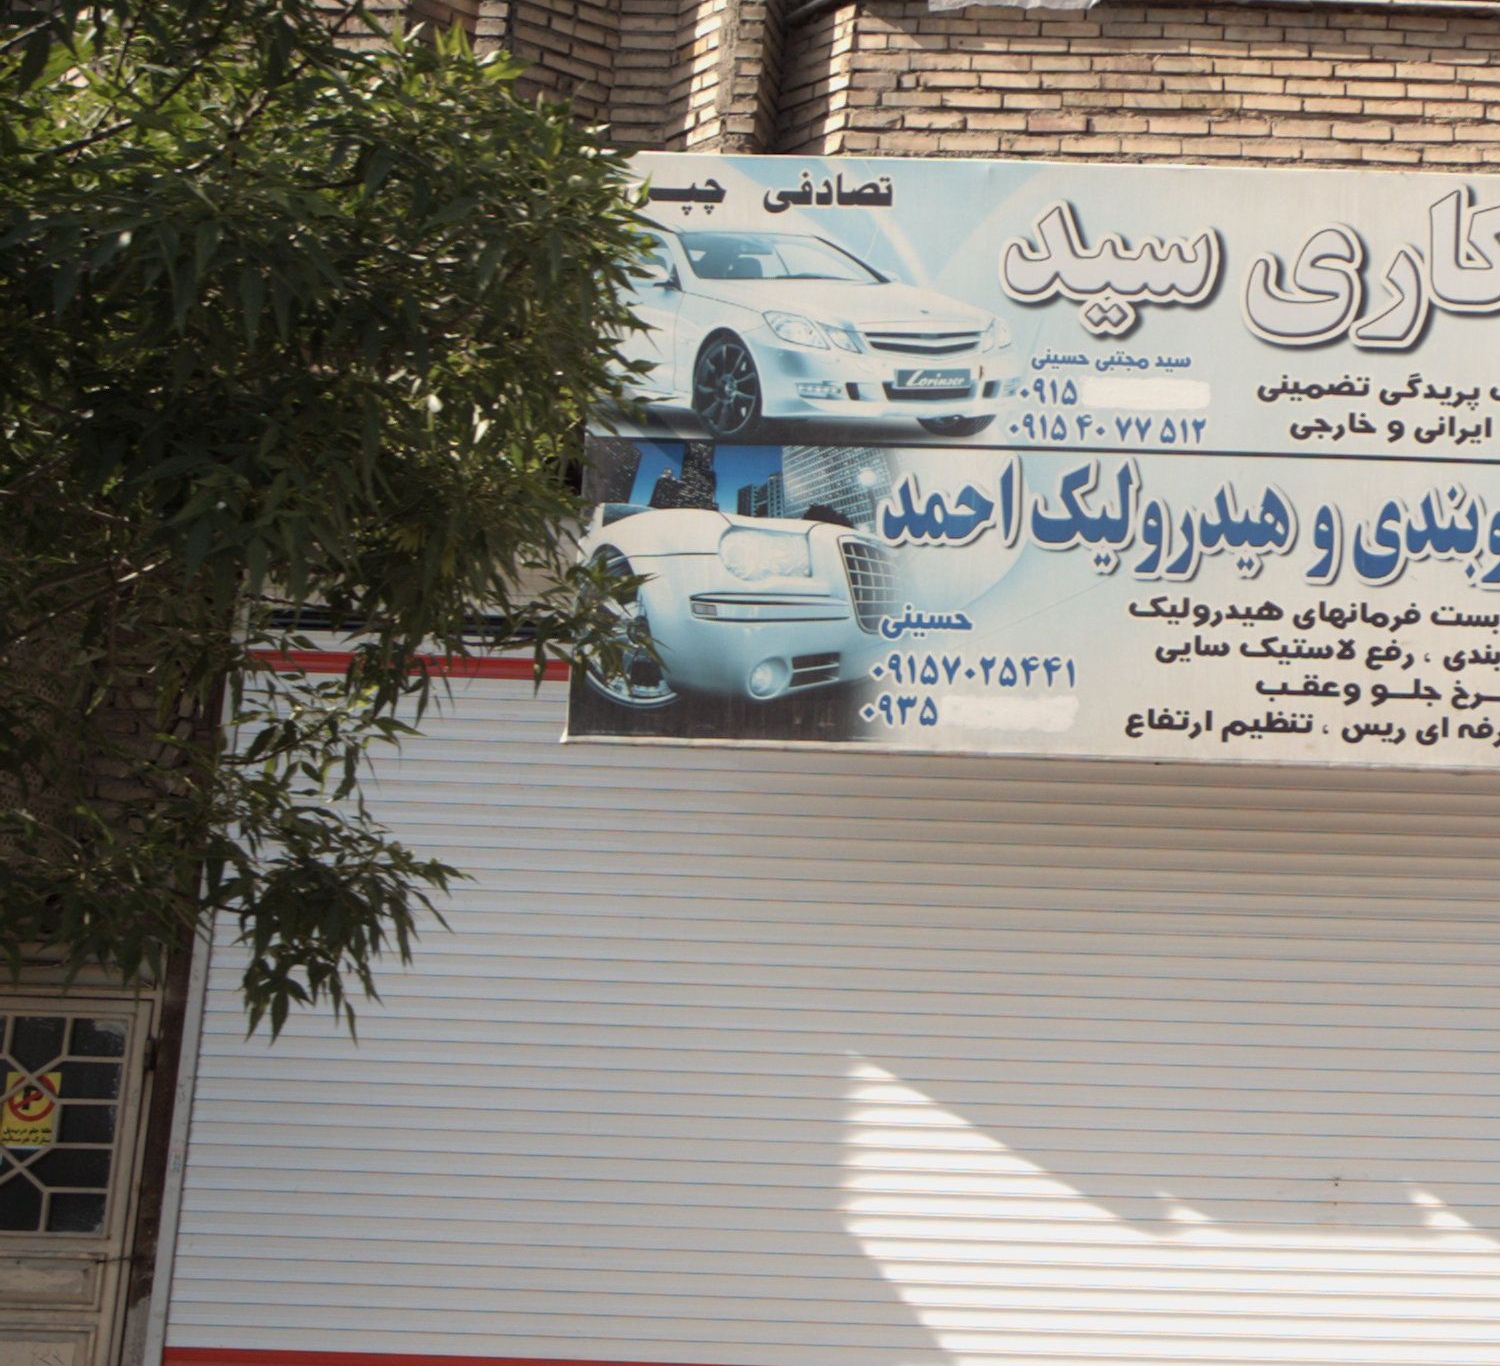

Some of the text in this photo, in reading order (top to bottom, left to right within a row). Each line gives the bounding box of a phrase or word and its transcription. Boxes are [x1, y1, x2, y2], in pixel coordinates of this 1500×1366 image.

[763, 171, 893, 214] تصادفی
[1001, 202, 1222, 332] سید
[1031, 354, 1191, 372] سید مجتبی حسینی
[1020, 378, 1077, 405] ۰۹۱۵
[1257, 374, 1370, 403] تضمینی
[1378, 372, 1480, 410] پریدگی
[1289, 412, 1377, 442] خارجی
[1413, 415, 1492, 446] ایرانی
[883, 464, 1014, 539] احمد
[1031, 465, 1290, 572] هیدرولیک
[1307, 506, 1334, 576] و
[879, 603, 972, 639] حسینی
[1128, 596, 1284, 628] هیدرولیک
[1292, 600, 1421, 633] فرمانهای
[1154, 634, 1231, 664] سایی
[1239, 636, 1356, 666] لاستیک
[1364, 639, 1415, 671] رفع
[873, 653, 1075, 687] ۰۹۱۵۷۰۲۵۴۴۱
[1370, 678, 1442, 708] جلو
[864, 694, 938, 726] ۰۹۳۵
[1124, 707, 1213, 740] ارتفاع
[1221, 711, 1314, 743] تنظیم
